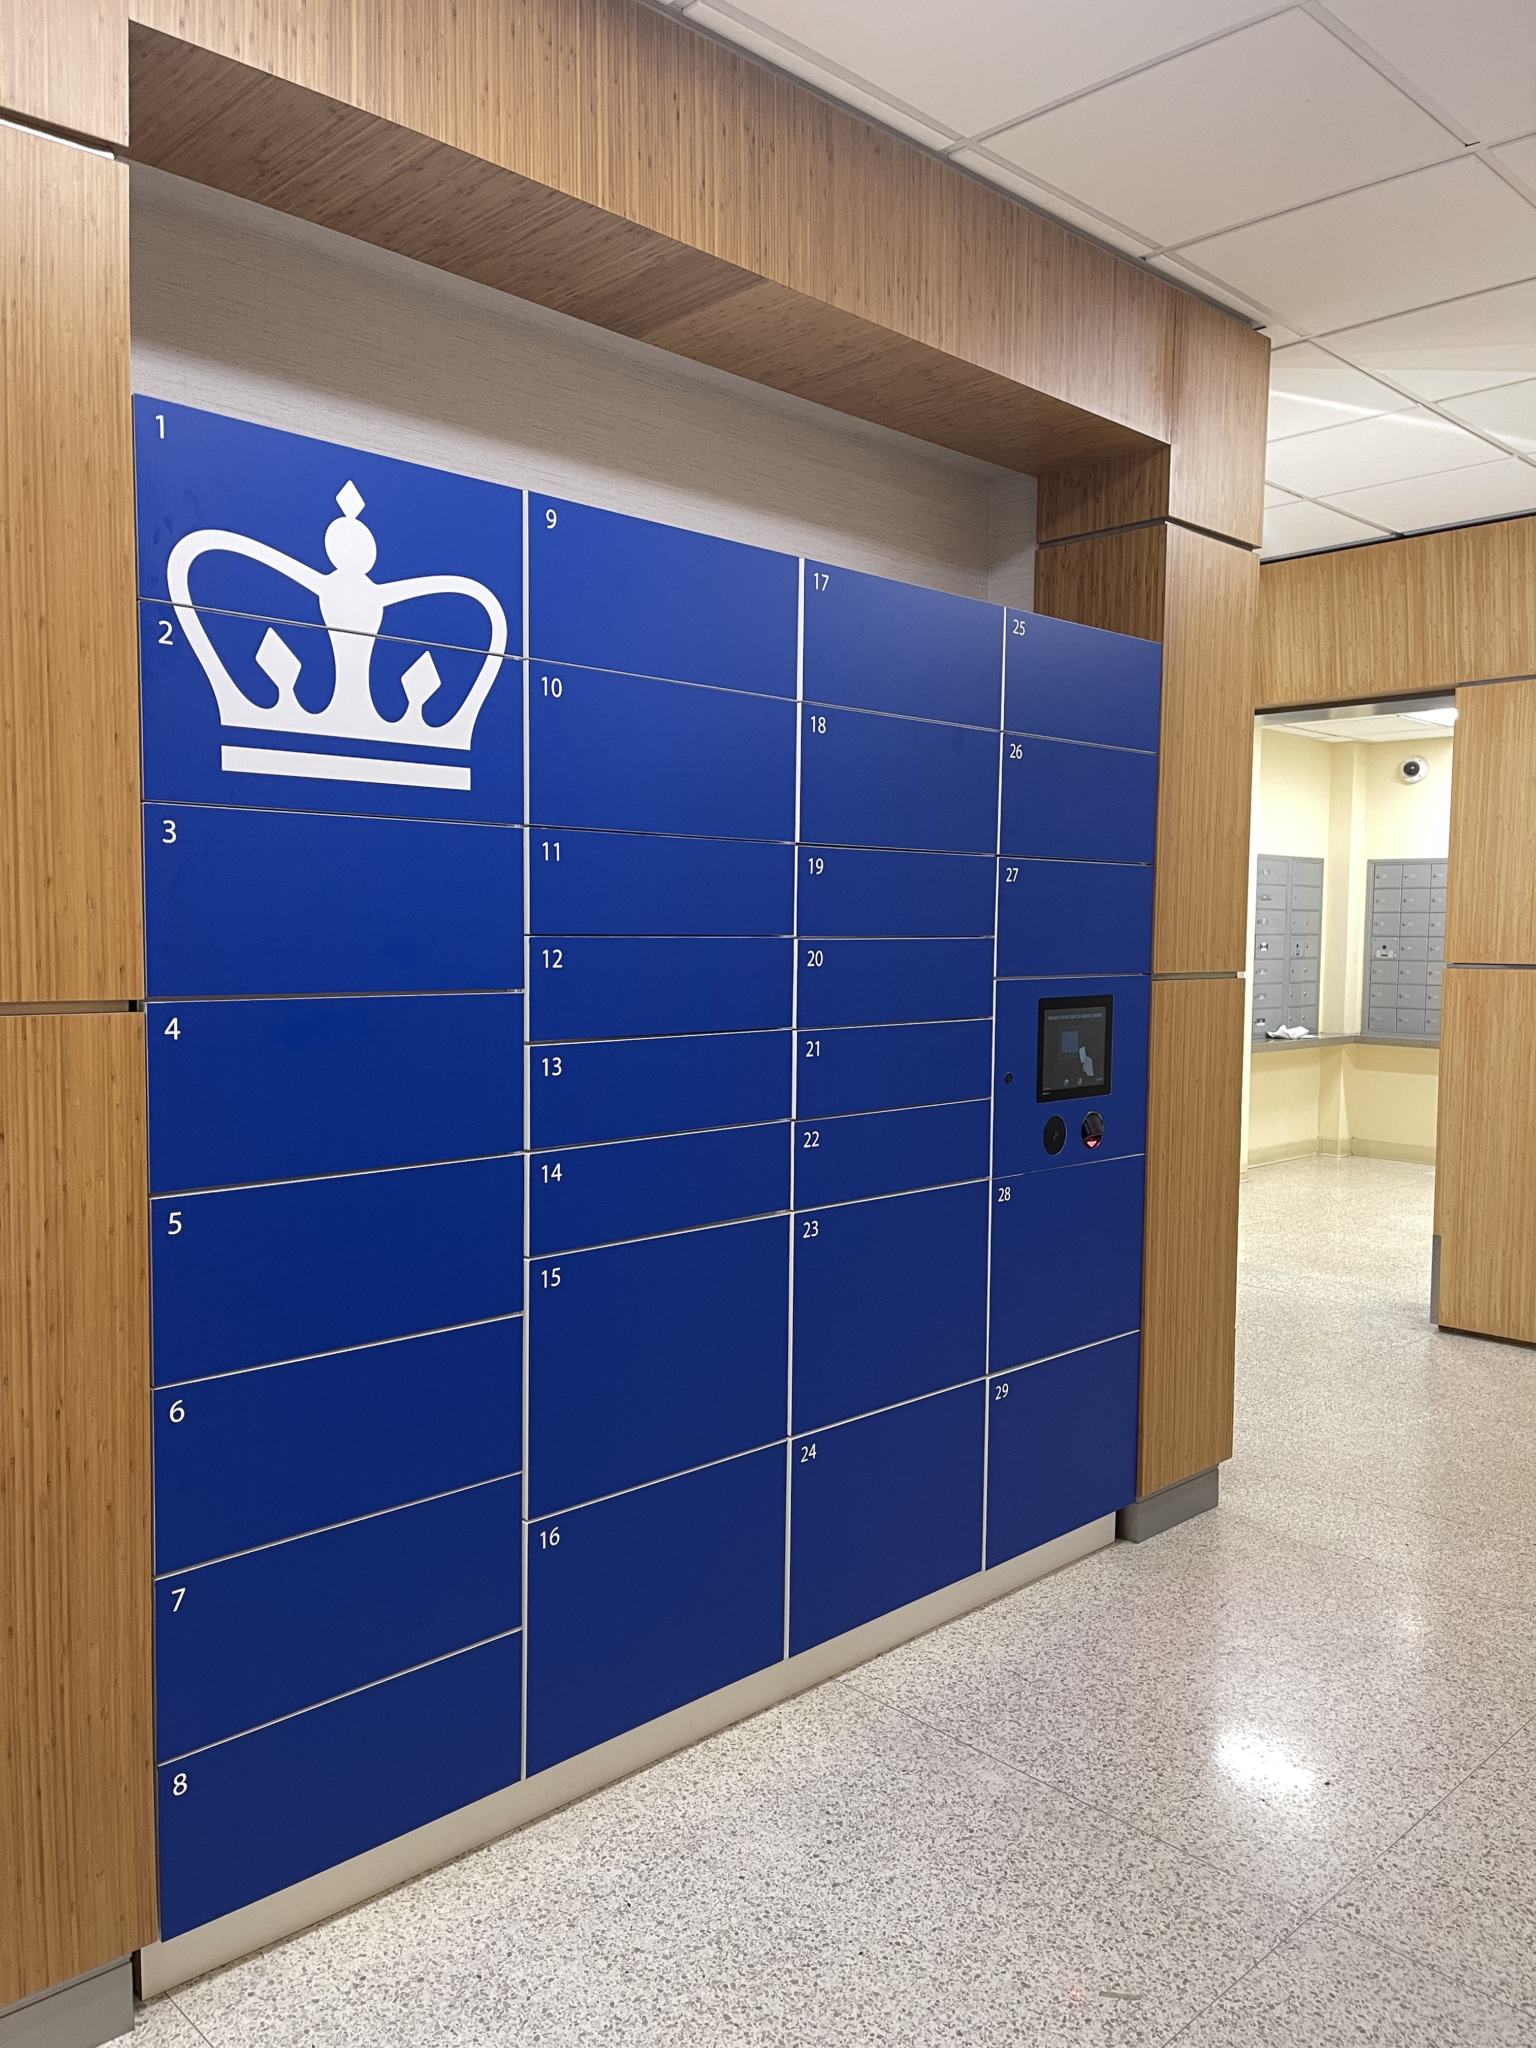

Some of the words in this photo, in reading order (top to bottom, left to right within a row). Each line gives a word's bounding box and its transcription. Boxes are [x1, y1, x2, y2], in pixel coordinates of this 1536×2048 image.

[155, 414, 165, 440] 1
[545, 508, 558, 530] 9
[813, 572, 830, 592] 17
[158, 620, 174, 646] 2
[1012, 618, 1026, 637] 25
[541, 676, 563, 698] 10
[810, 715, 827, 734] 18
[1009, 743, 1023, 760] 26
[162, 819, 177, 844] 3
[542, 841, 560, 862] 11
[808, 857, 824, 875] 19
[1005, 867, 1019, 883] 27
[542, 948, 563, 969] 12
[806, 950, 824, 967] 20
[164, 1017, 181, 1041] 4
[805, 1040, 820, 1058] 21
[541, 1056, 562, 1077] 13
[803, 1130, 820, 1149] 22
[541, 1162, 563, 1184] 14
[997, 1186, 1011, 1203] 28
[167, 1211, 182, 1235] 5
[802, 1220, 819, 1239] 23
[541, 1267, 561, 1289] 15
[995, 1383, 1009, 1401] 29
[169, 1399, 185, 1423] 6
[800, 1443, 817, 1463] 24
[539, 1526, 560, 1550] 16
[171, 1587, 186, 1613] 7
[172, 1772, 188, 1796] 8
